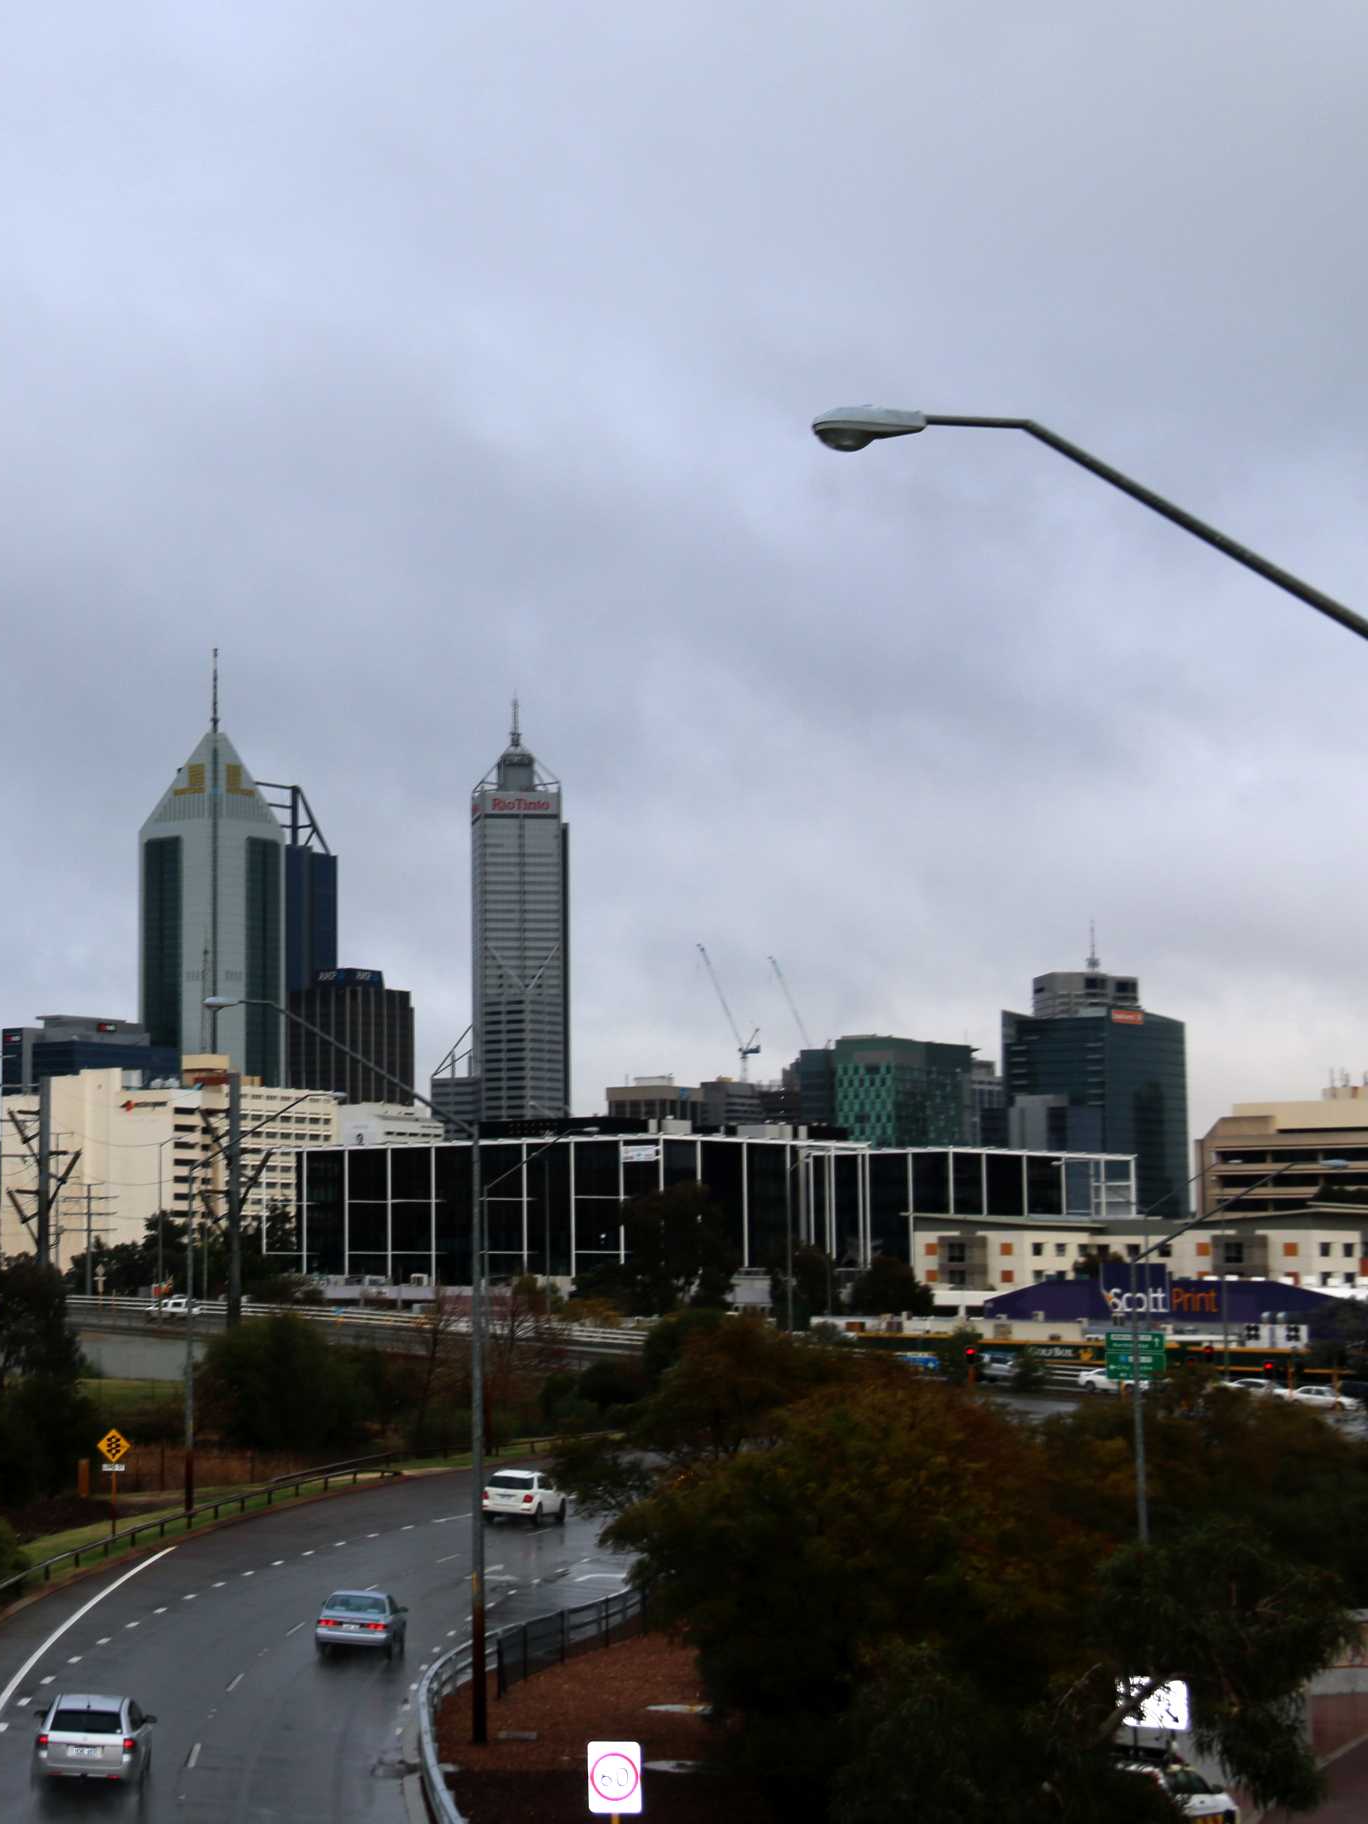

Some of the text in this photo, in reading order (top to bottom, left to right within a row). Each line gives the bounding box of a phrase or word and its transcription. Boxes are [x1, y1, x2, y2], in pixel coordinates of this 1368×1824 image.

[1111, 1287, 1219, 1312] Scott Print
[600, 1766, 629, 1787] 60
